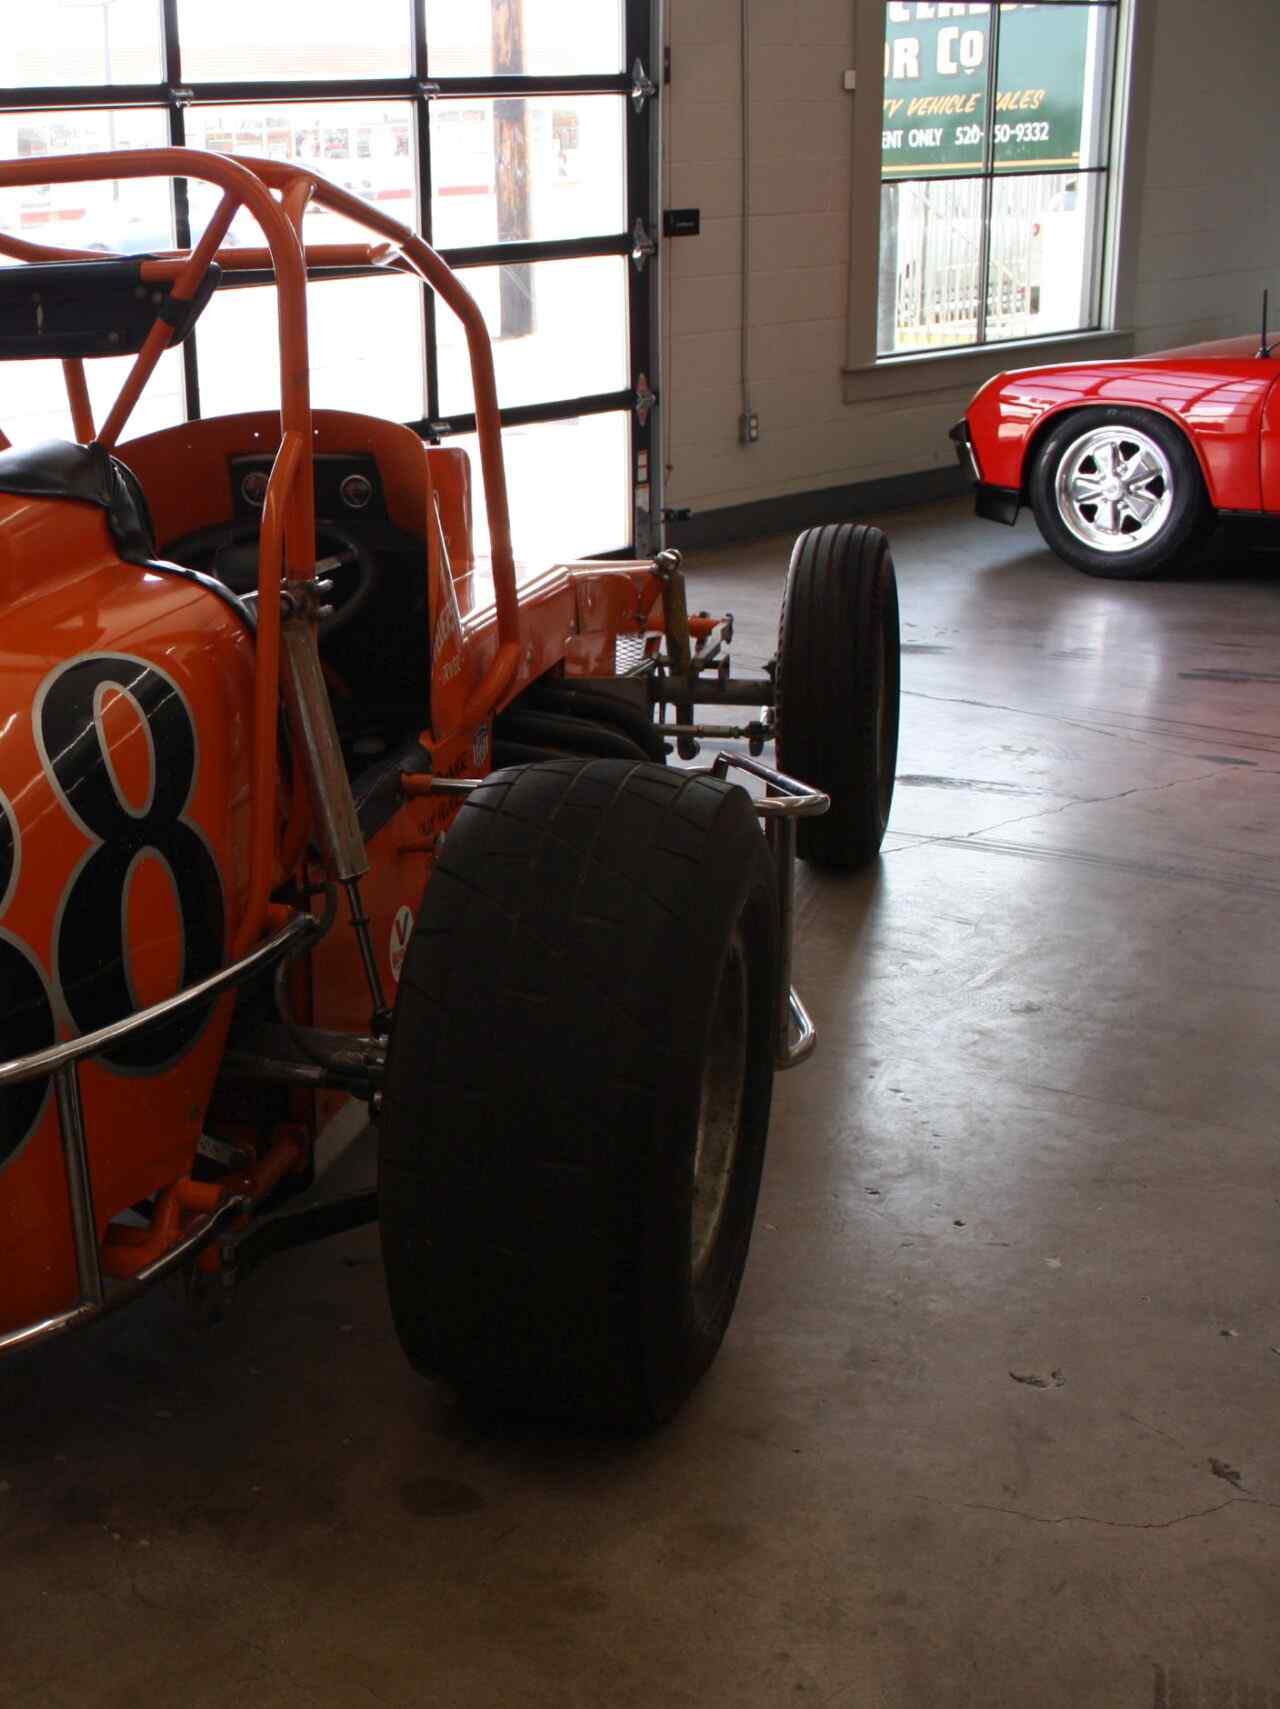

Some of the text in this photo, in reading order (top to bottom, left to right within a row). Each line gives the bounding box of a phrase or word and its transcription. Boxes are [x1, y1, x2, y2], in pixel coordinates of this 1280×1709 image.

[884, 37, 919, 79] R
[907, 93, 981, 116] VEHICLE
[996, 89, 1046, 112] ALES
[908, 127, 944, 148] ONLY
[955, 121, 1049, 145] 520-50-9332
